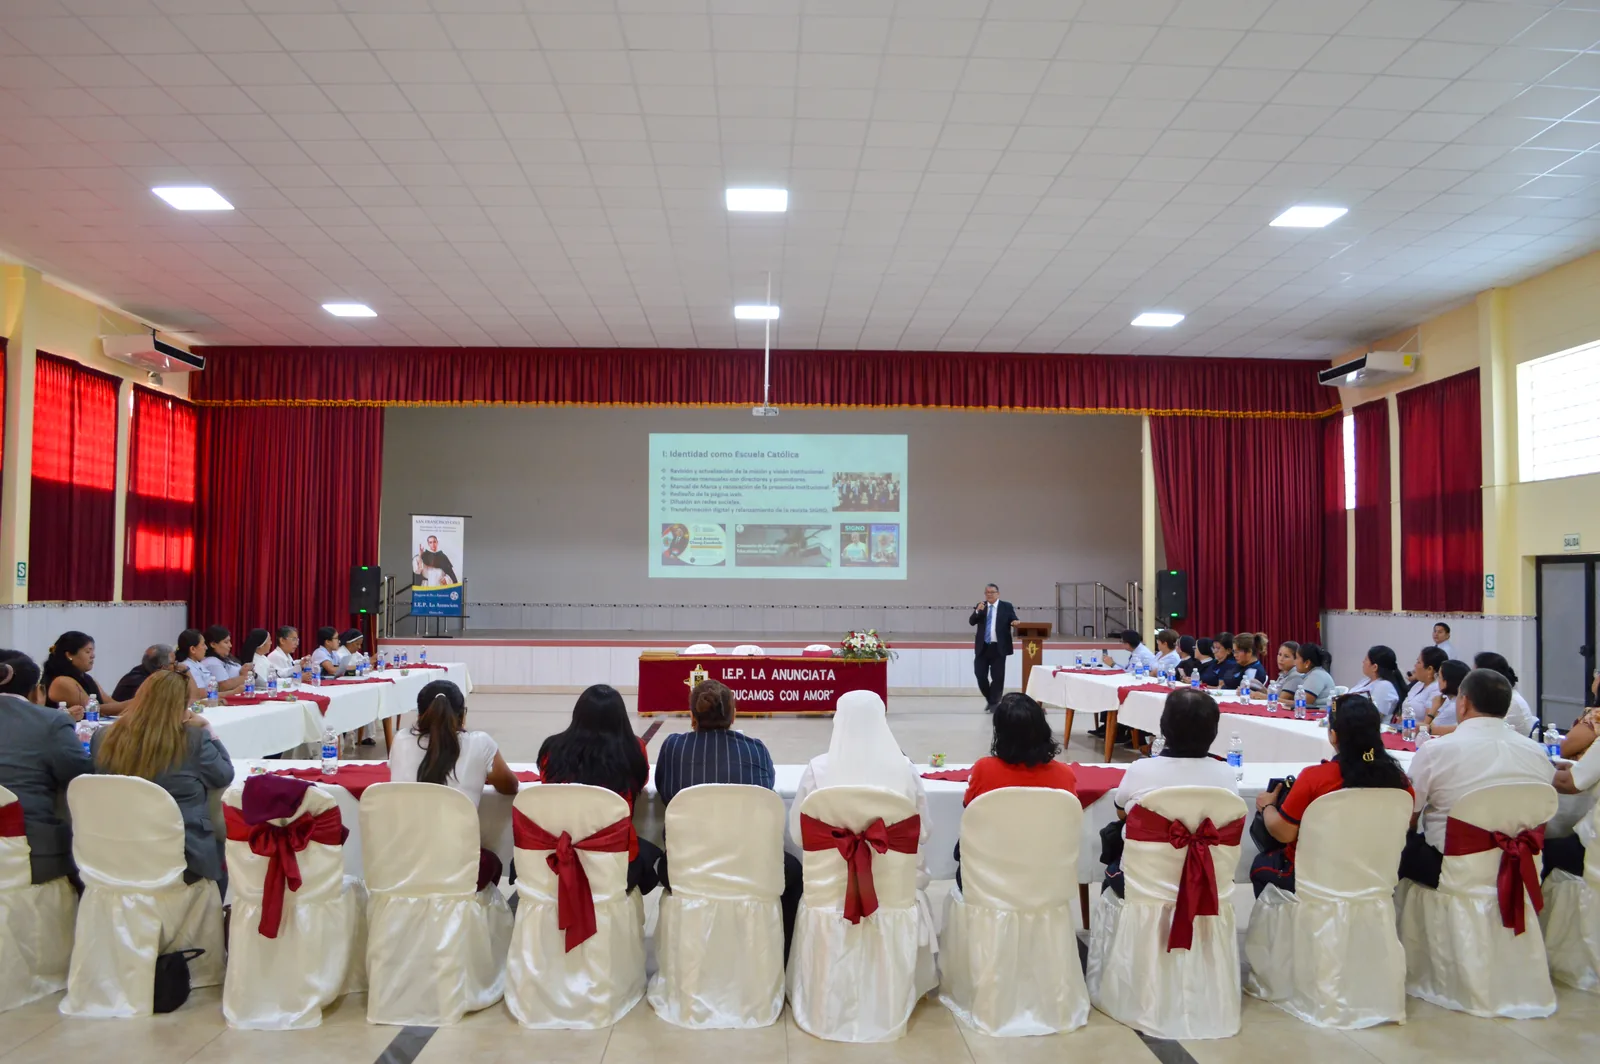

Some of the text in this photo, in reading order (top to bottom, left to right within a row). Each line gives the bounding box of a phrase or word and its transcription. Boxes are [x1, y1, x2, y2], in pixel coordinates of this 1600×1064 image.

[669, 449, 709, 458] Identidad
[735, 450, 765, 458] Escuela
[766, 450, 800, 458] Católica
[1564, 538, 1580, 547] SALIDA
[18, 563, 26, 577] S
[1486, 575, 1494, 588] S
[722, 668, 836, 680] I.E.P. LA ANUNCIATA
[780, 690, 800, 701] CON
